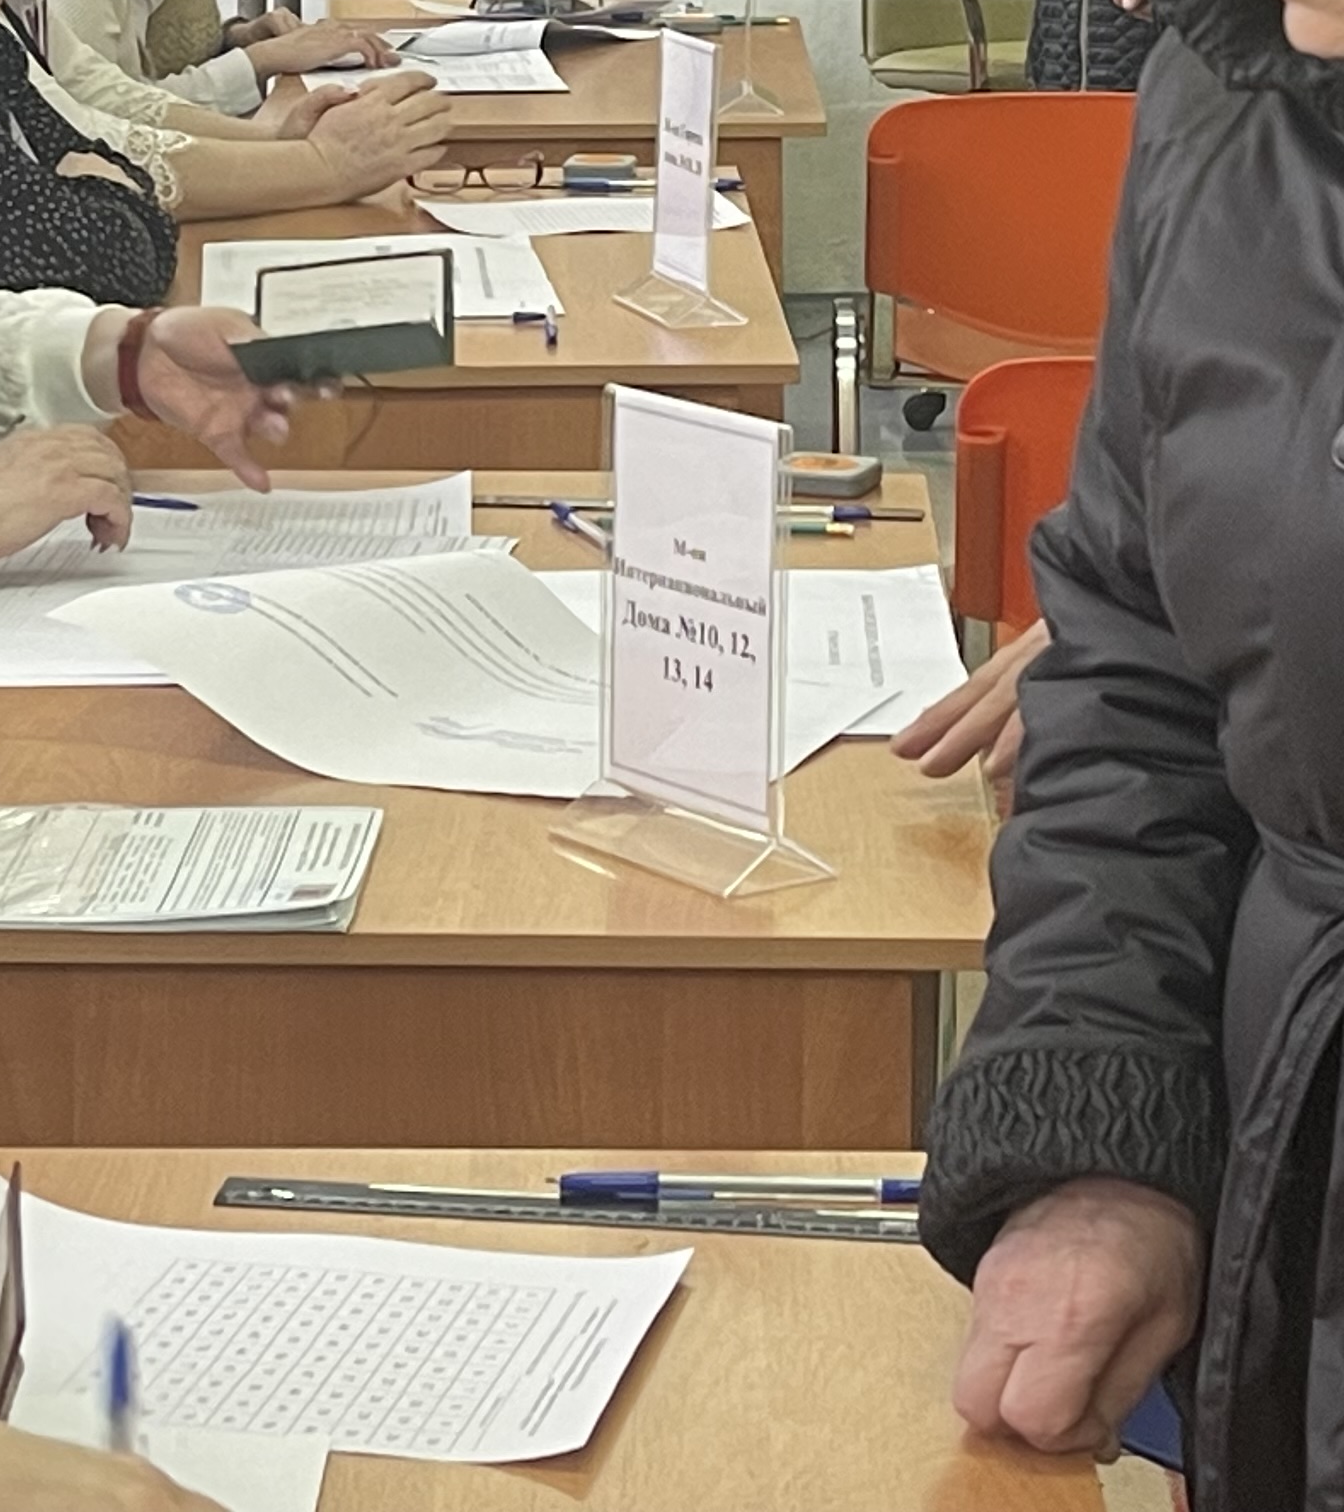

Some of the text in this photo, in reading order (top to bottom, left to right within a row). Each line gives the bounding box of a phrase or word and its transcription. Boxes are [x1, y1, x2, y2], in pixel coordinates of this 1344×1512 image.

[621, 600, 757, 664] Дома №10, 12,
[662, 655, 714, 694] 13, 14
